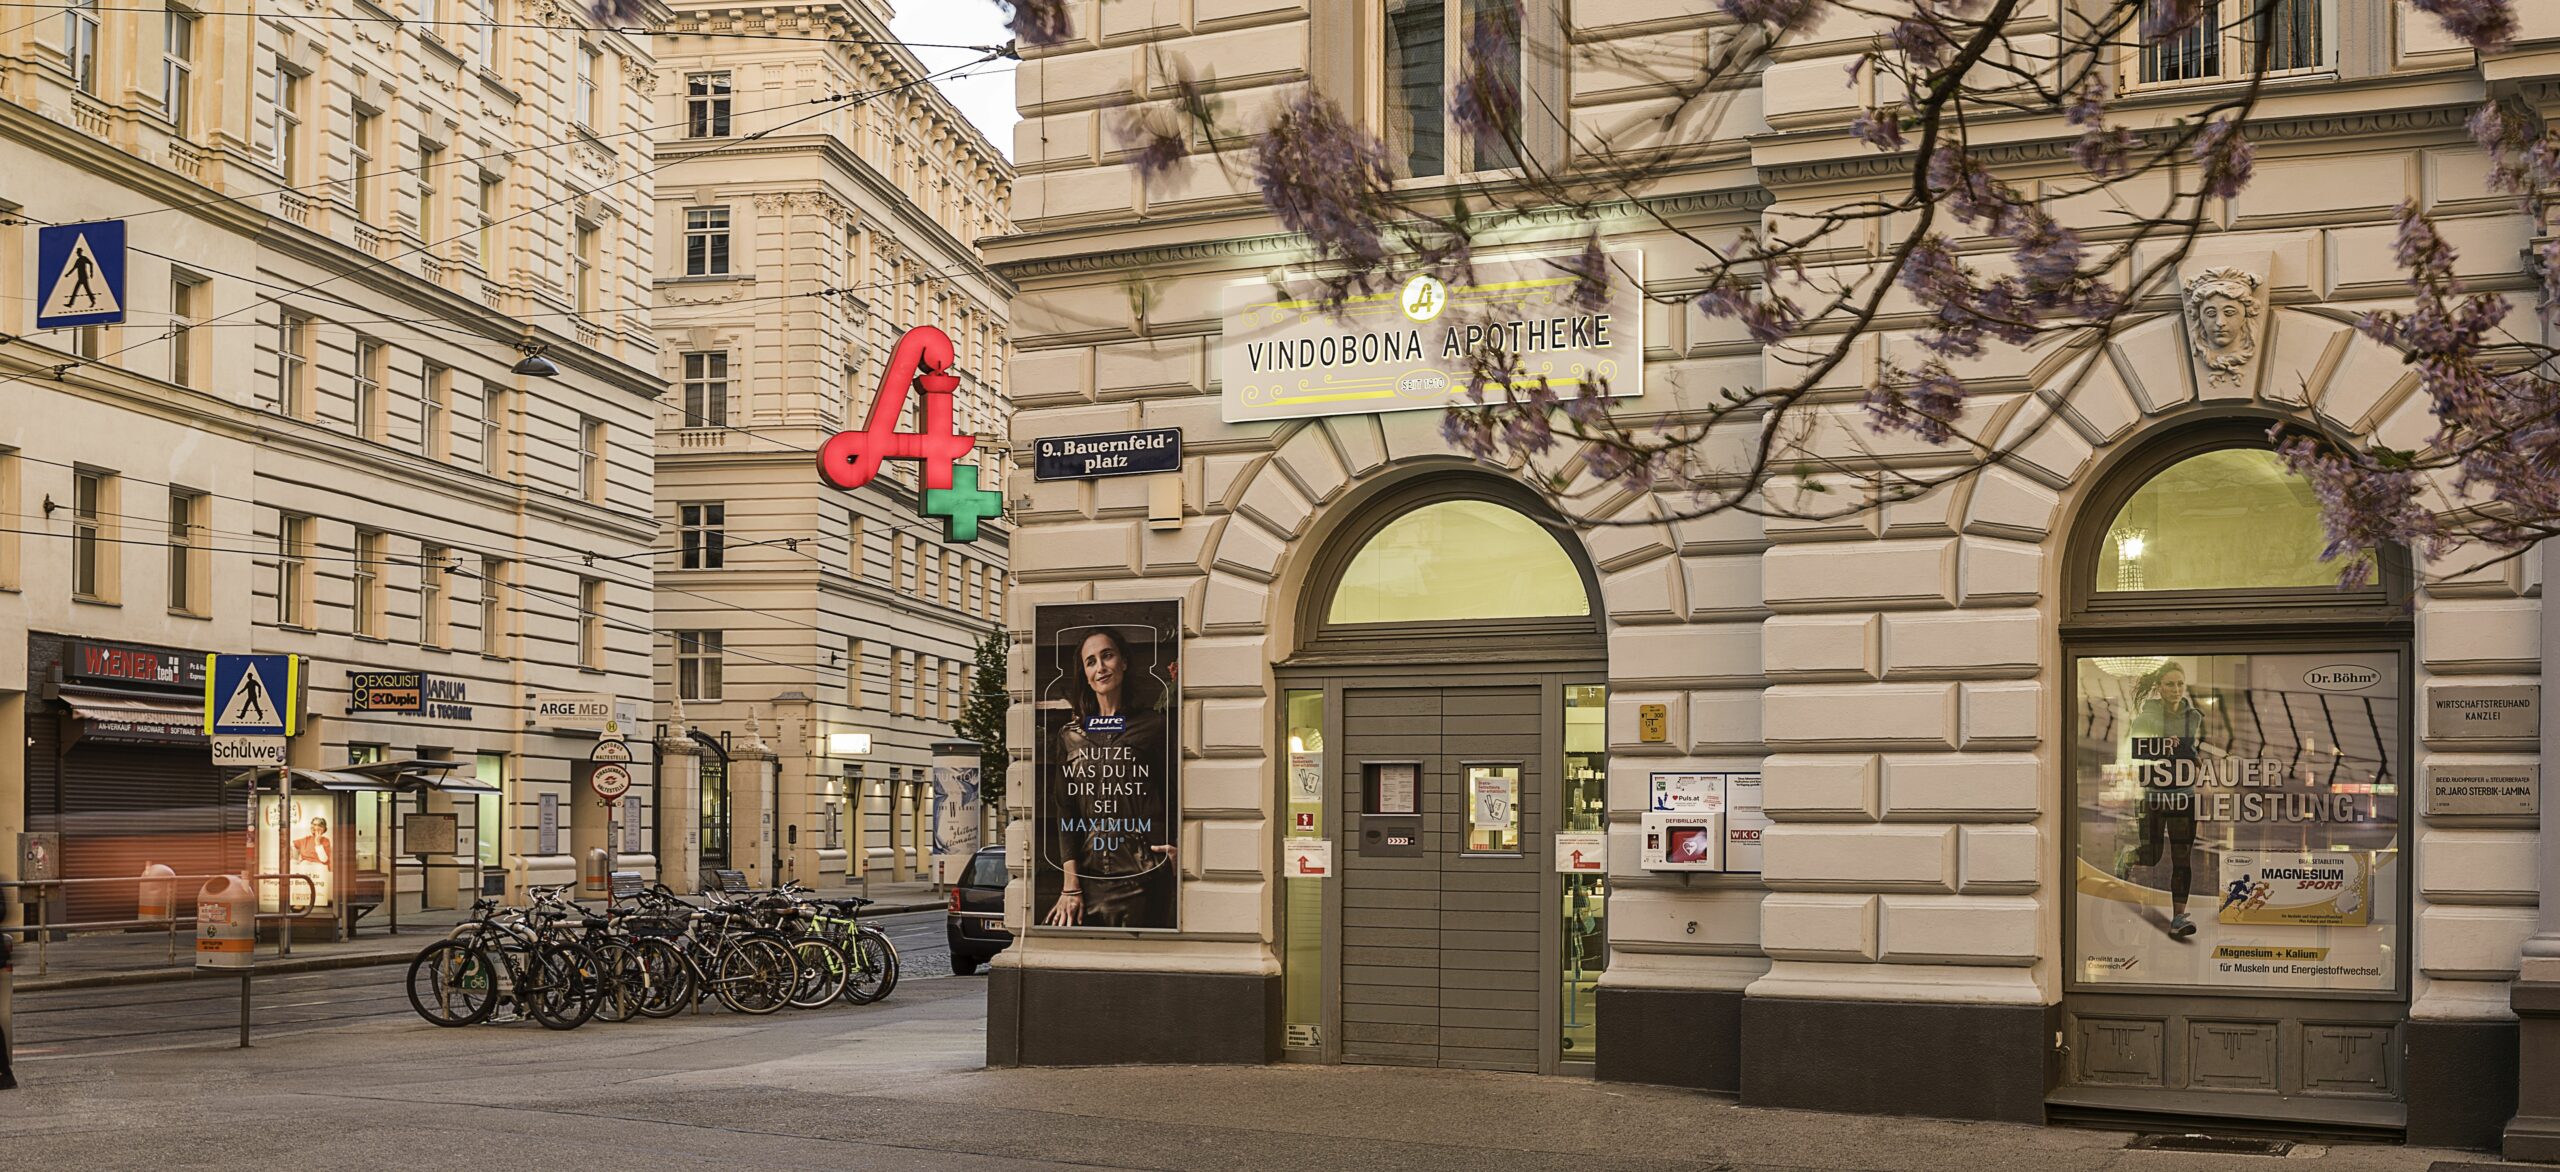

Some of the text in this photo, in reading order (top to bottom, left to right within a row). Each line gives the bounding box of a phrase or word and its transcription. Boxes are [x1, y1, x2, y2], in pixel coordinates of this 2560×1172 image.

[1248, 314, 1611, 372] VINDOBONA APOTHEKE
[1402, 379, 1421, 390] SEIT
[1085, 454, 1128, 473] platz
[157, 665, 174, 682] tech
[2311, 673, 2331, 683] Dr.
[354, 675, 419, 709] ZOO EXQUISIT
[540, 703, 609, 715] ARGE MED
[2436, 699, 2530, 709] WIRTSCHAFTSTREUHAND
[1089, 717, 1123, 726] pure
[2465, 711, 2501, 721] KANZLEI
[98, 723, 131, 732] AN-VERKAUF
[137, 725, 165, 734] HARDWARE
[171, 727, 196, 736] SOFTWARE
[2137, 735, 2174, 755] FÜR
[1079, 747, 1136, 762] NUTZE,
[1062, 764, 1149, 778] WAS DU IN
[1068, 782, 1147, 795] DIR HAST.
[2469, 787, 2531, 796] STERBIK-LAMINA
[1094, 800, 1117, 813] SEI
[2150, 793, 2364, 822] UND LEISTUNG.
[1061, 818, 1151, 832] MAXIMUM
[2262, 868, 2344, 880] MAGNESIUM
[2220, 948, 2273, 959] Magnesium
[2286, 949, 2318, 959] Kalium
[2220, 963, 2381, 977] für Muskeln und Energiestoffwechsel.
